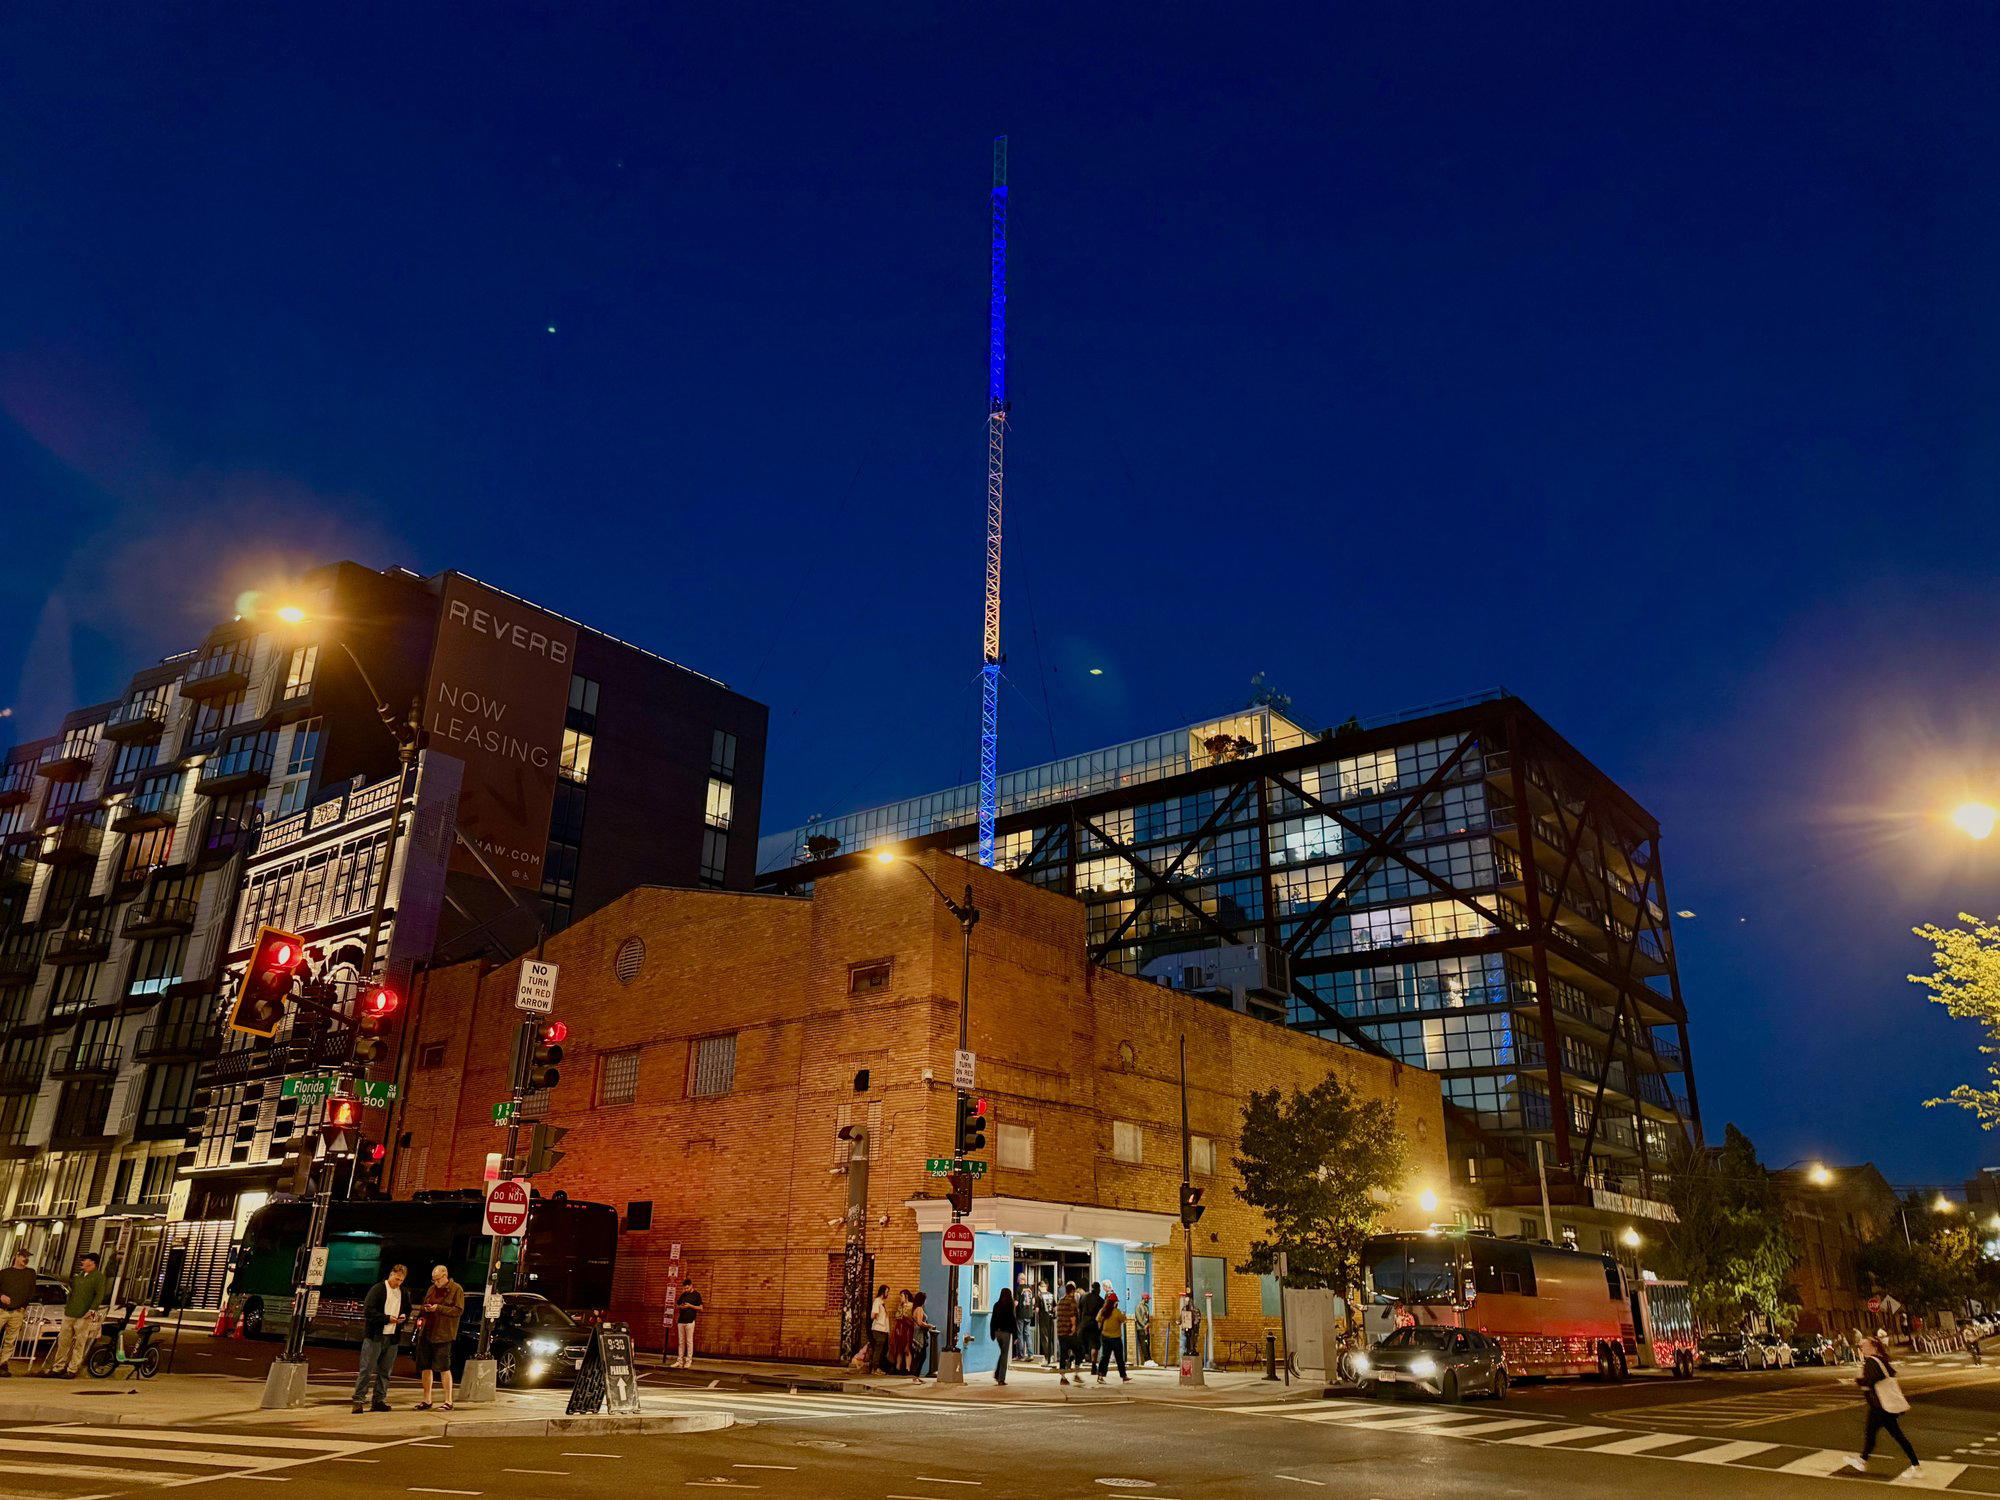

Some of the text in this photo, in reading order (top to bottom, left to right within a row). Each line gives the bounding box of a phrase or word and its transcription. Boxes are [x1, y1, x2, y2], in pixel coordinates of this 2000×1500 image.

[449, 600, 567, 664] REVERB
[438, 682, 507, 722] NOW
[433, 712, 549, 768] LEASING
[532, 964, 548, 975] NO
[528, 976, 549, 986] TURN
[521, 986, 551, 998] ON RED
[520, 997, 549, 1009] ARROW
[961, 1053, 970, 1061] NO
[293, 1080, 325, 1093] Florida
[364, 1081, 376, 1095] V
[301, 1094, 317, 1105] 900
[497, 1104, 503, 1116] 9
[933, 1160, 939, 1170] 9
[493, 1191, 525, 1202] DO NOT
[493, 1214, 518, 1225] ENTER
[947, 1231, 970, 1240] DO NOT
[948, 1249, 968, 1257] ENTER
[608, 1339, 625, 1350] 9:30
